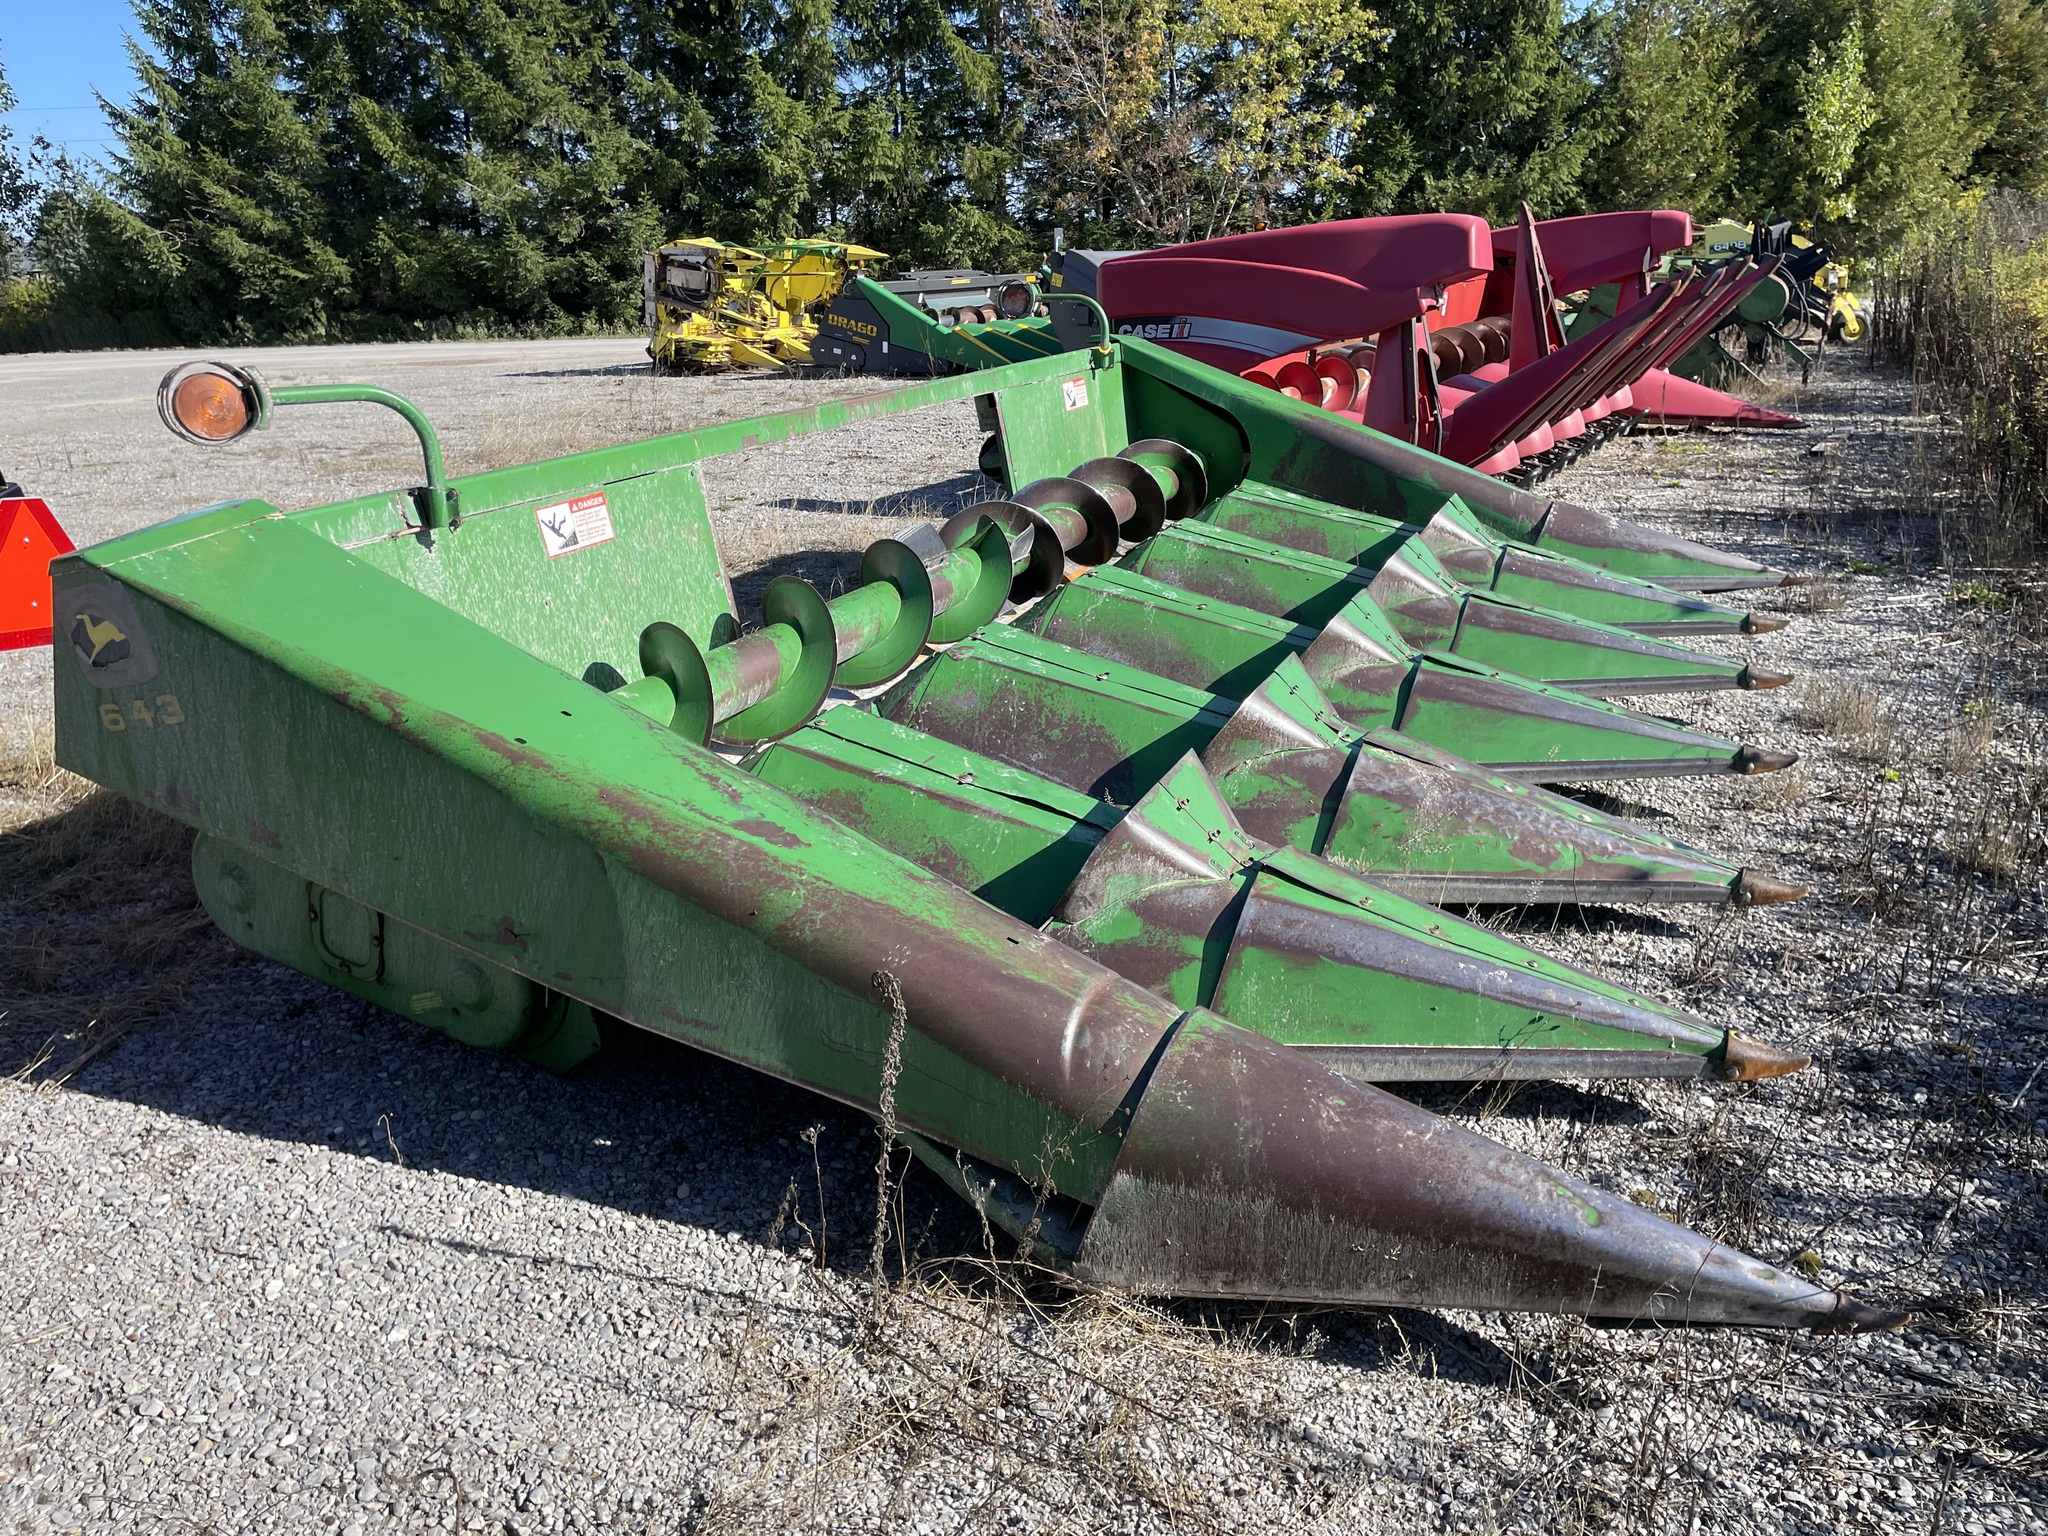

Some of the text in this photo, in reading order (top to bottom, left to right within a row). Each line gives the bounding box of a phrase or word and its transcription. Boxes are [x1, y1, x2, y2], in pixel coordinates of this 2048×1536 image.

[828, 313, 877, 337] DRAGO
[1118, 324, 1171, 338] CASE
[578, 496, 604, 509] DANGER
[99, 695, 185, 732] 643
